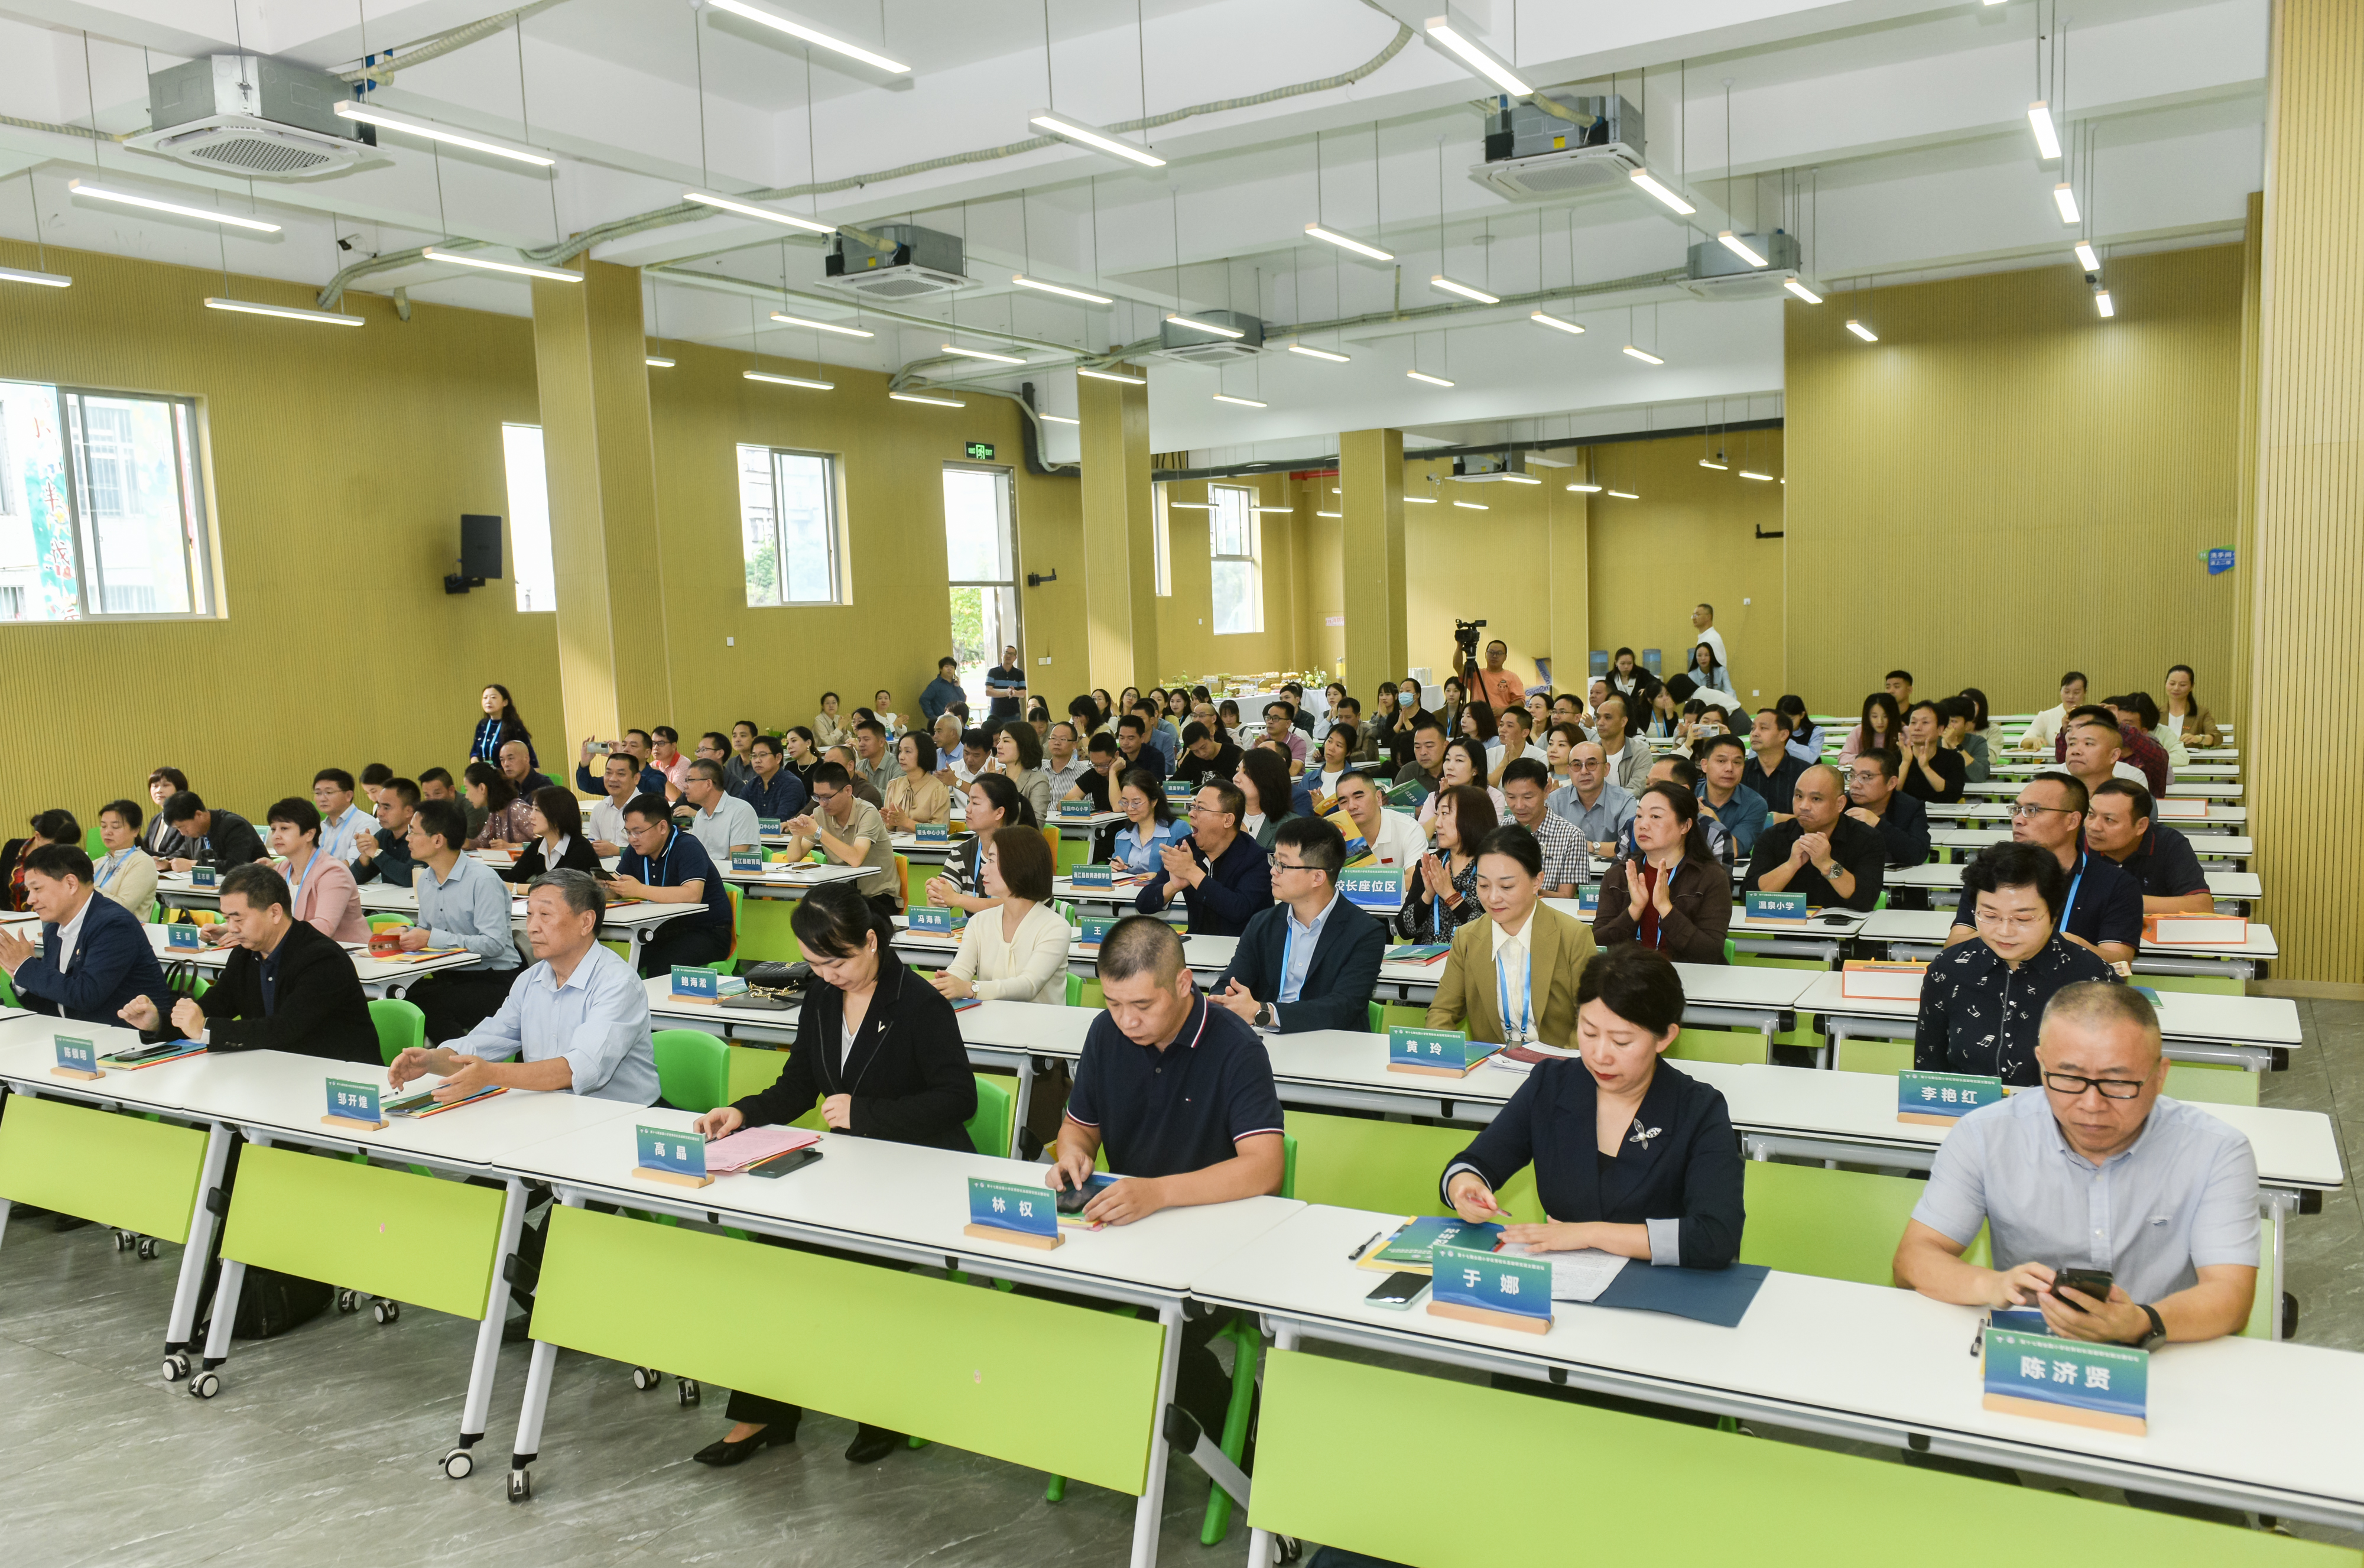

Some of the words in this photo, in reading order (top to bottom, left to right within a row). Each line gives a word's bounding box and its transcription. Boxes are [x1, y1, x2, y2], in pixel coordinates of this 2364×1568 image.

[1758, 901, 1794, 911] 温泉小学
[918, 914, 941, 924] 冯海燕
[681, 976, 707, 988] 鲍海淞
[1406, 1040, 1443, 1056] 黄玲
[337, 1092, 368, 1109] 邹开煌
[1921, 1086, 1977, 1105] 李艳红
[654, 1141, 687, 1161] 高晶
[992, 1196, 1033, 1218] 林权
[1463, 1268, 1519, 1295] 于娜
[2021, 1355, 2111, 1391] 陈济贤
